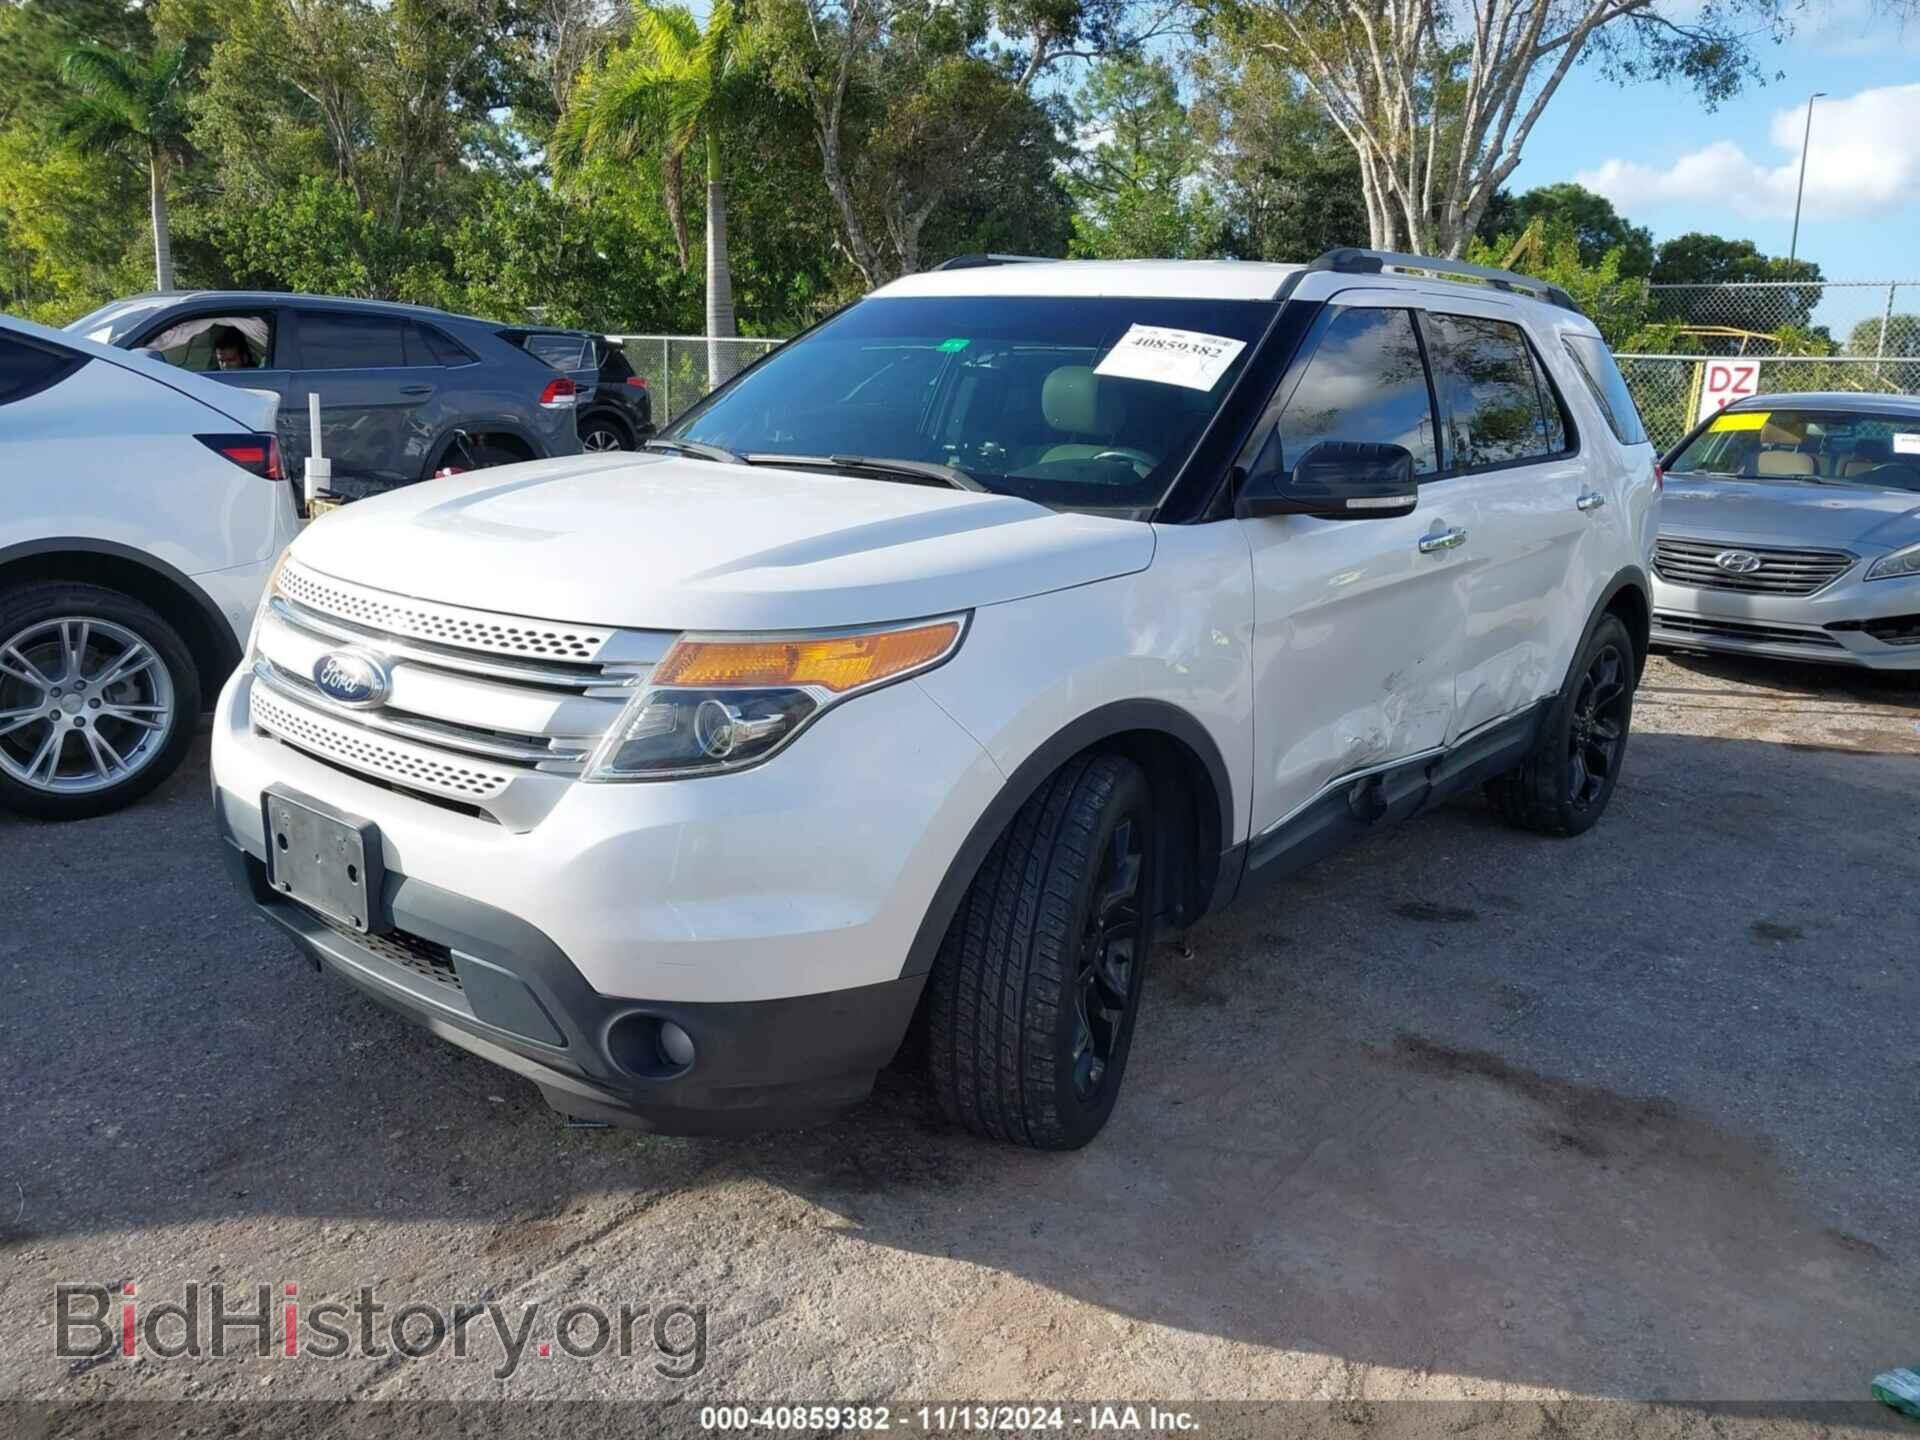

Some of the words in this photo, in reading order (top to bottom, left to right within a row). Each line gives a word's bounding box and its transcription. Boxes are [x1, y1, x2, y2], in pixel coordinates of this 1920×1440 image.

[1131, 337, 1223, 358] 40859382
[1709, 366, 1754, 393] DZ
[320, 658, 359, 692] Ford
